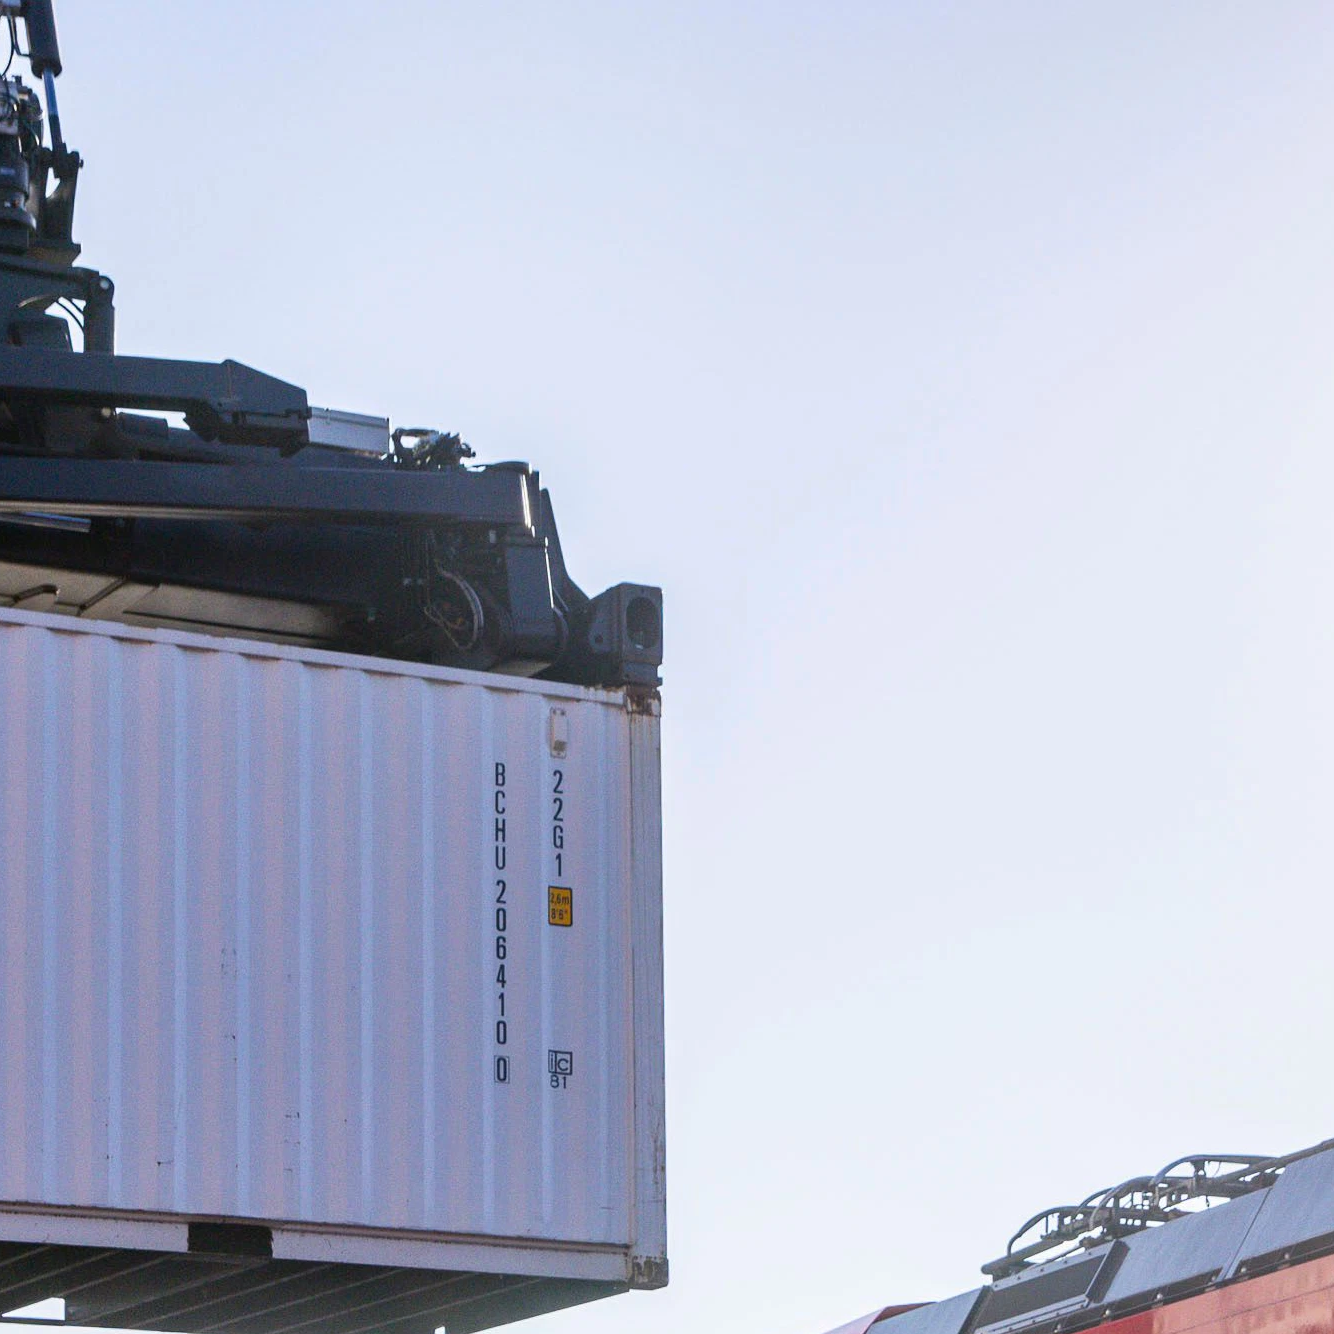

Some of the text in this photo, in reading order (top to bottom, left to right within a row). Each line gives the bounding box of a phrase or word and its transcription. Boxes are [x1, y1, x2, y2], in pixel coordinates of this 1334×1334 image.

[494, 762, 508, 1083] BCHU 206410 0
[552, 769, 565, 877] 22G1
